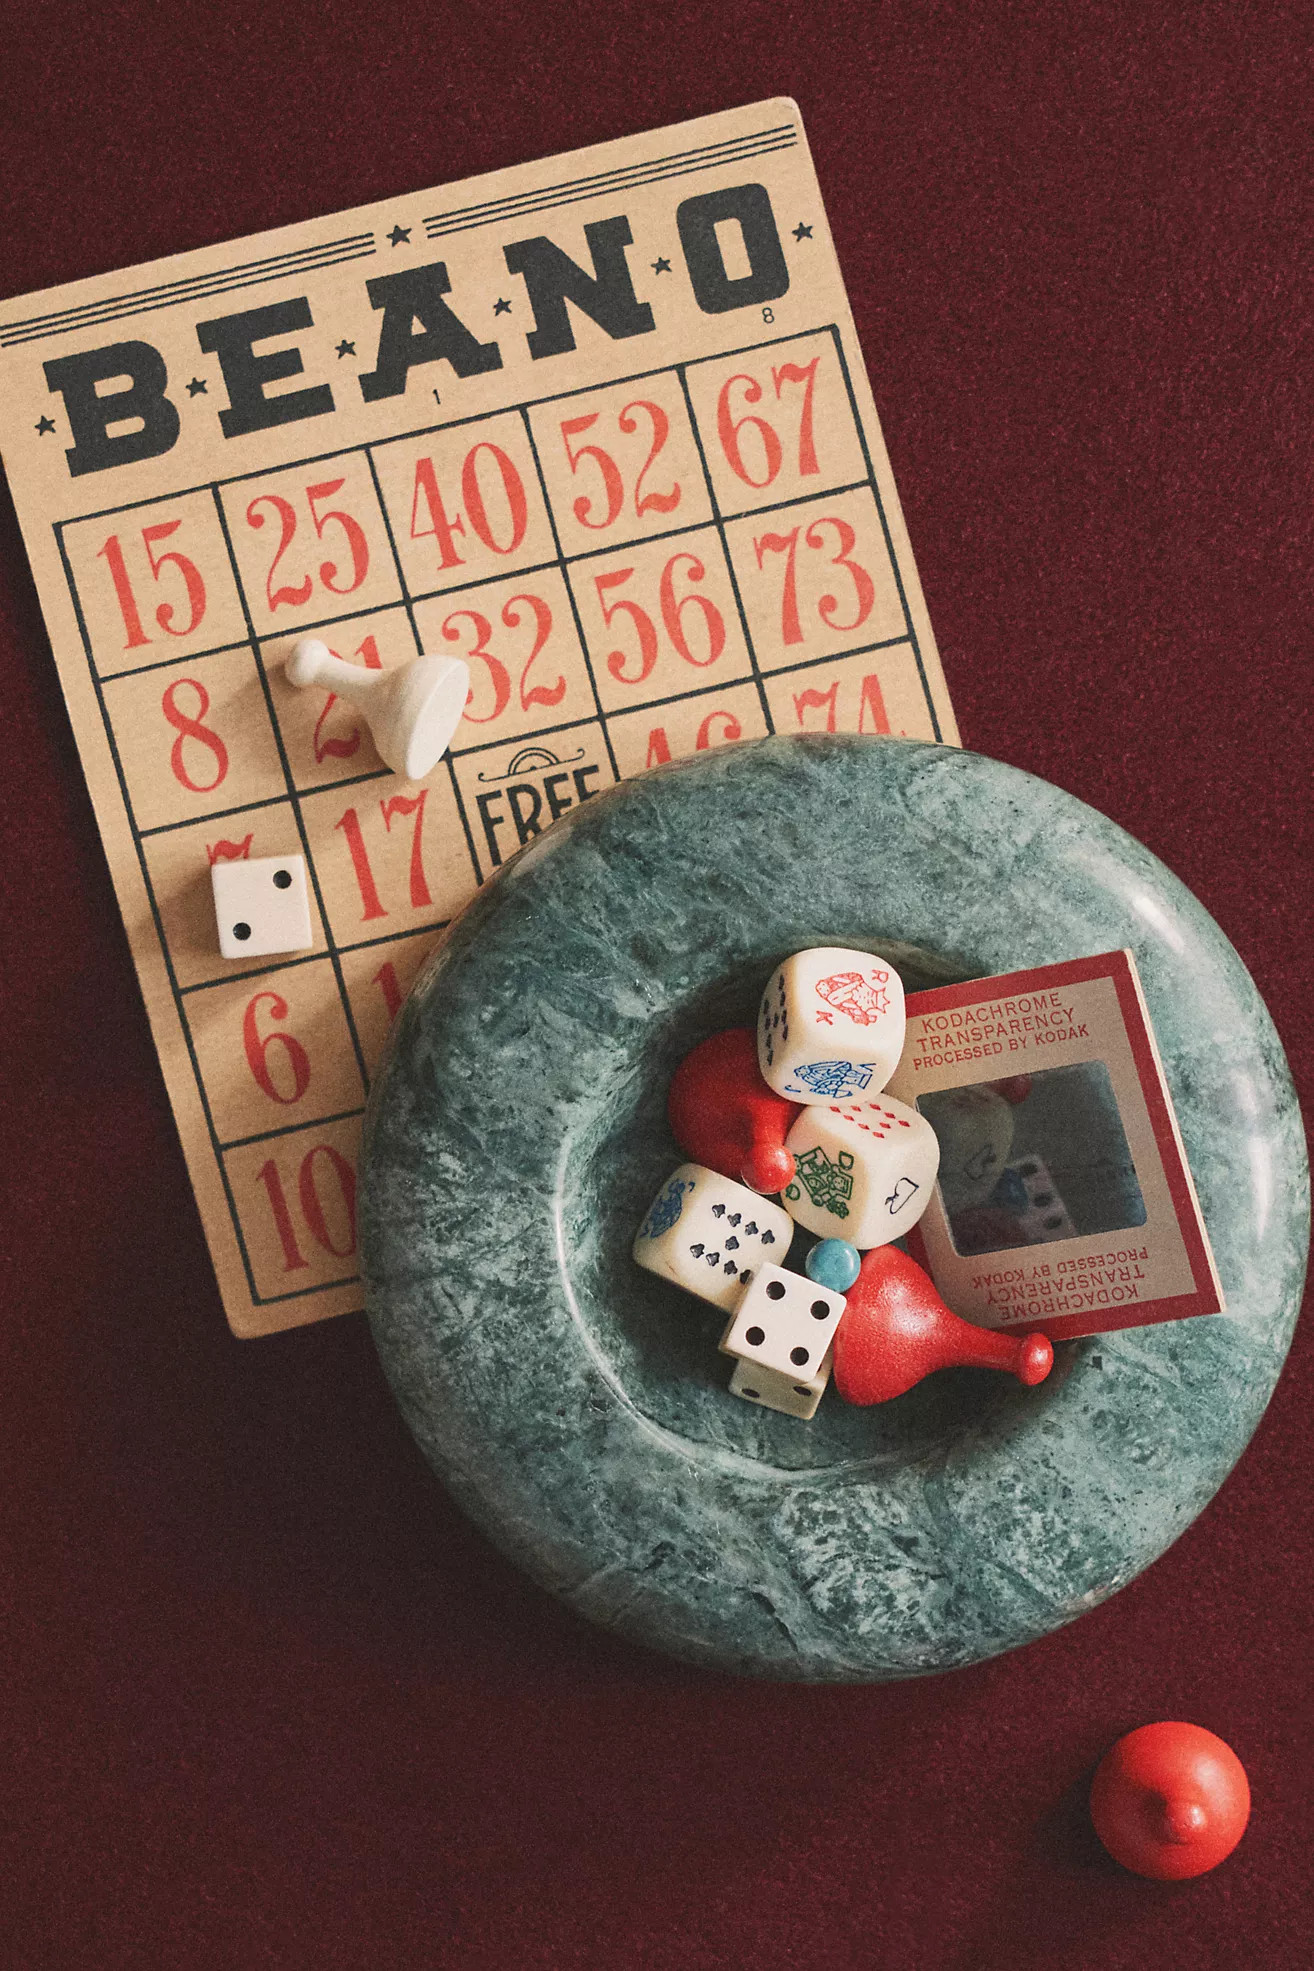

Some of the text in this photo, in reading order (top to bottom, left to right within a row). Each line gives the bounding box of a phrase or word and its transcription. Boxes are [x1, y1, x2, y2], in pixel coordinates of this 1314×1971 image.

[43, 183, 790, 477] BEANO
[762, 307, 775, 323] 8
[97, 356, 821, 649] 15 25 40 52 67
[161, 678, 229, 793] 8
[441, 594, 567, 723] 32
[594, 553, 726, 685] 56
[753, 517, 875, 645] 73
[334, 789, 433, 921] 17
[917, 1007, 1074, 1052] TRANSPARENCY
[921, 992, 1062, 1033] KODACHROME
[242, 991, 312, 1105] 6
[913, 1024, 1089, 1070] PROCESSED BY KODAK
[255, 1144, 358, 1273] 10
[972, 1247, 1149, 1289] PROCESSED BY KODAK
[987, 1264, 1145, 1305] TRANSPARENCY
[998, 1283, 1139, 1320] KODACHROME
